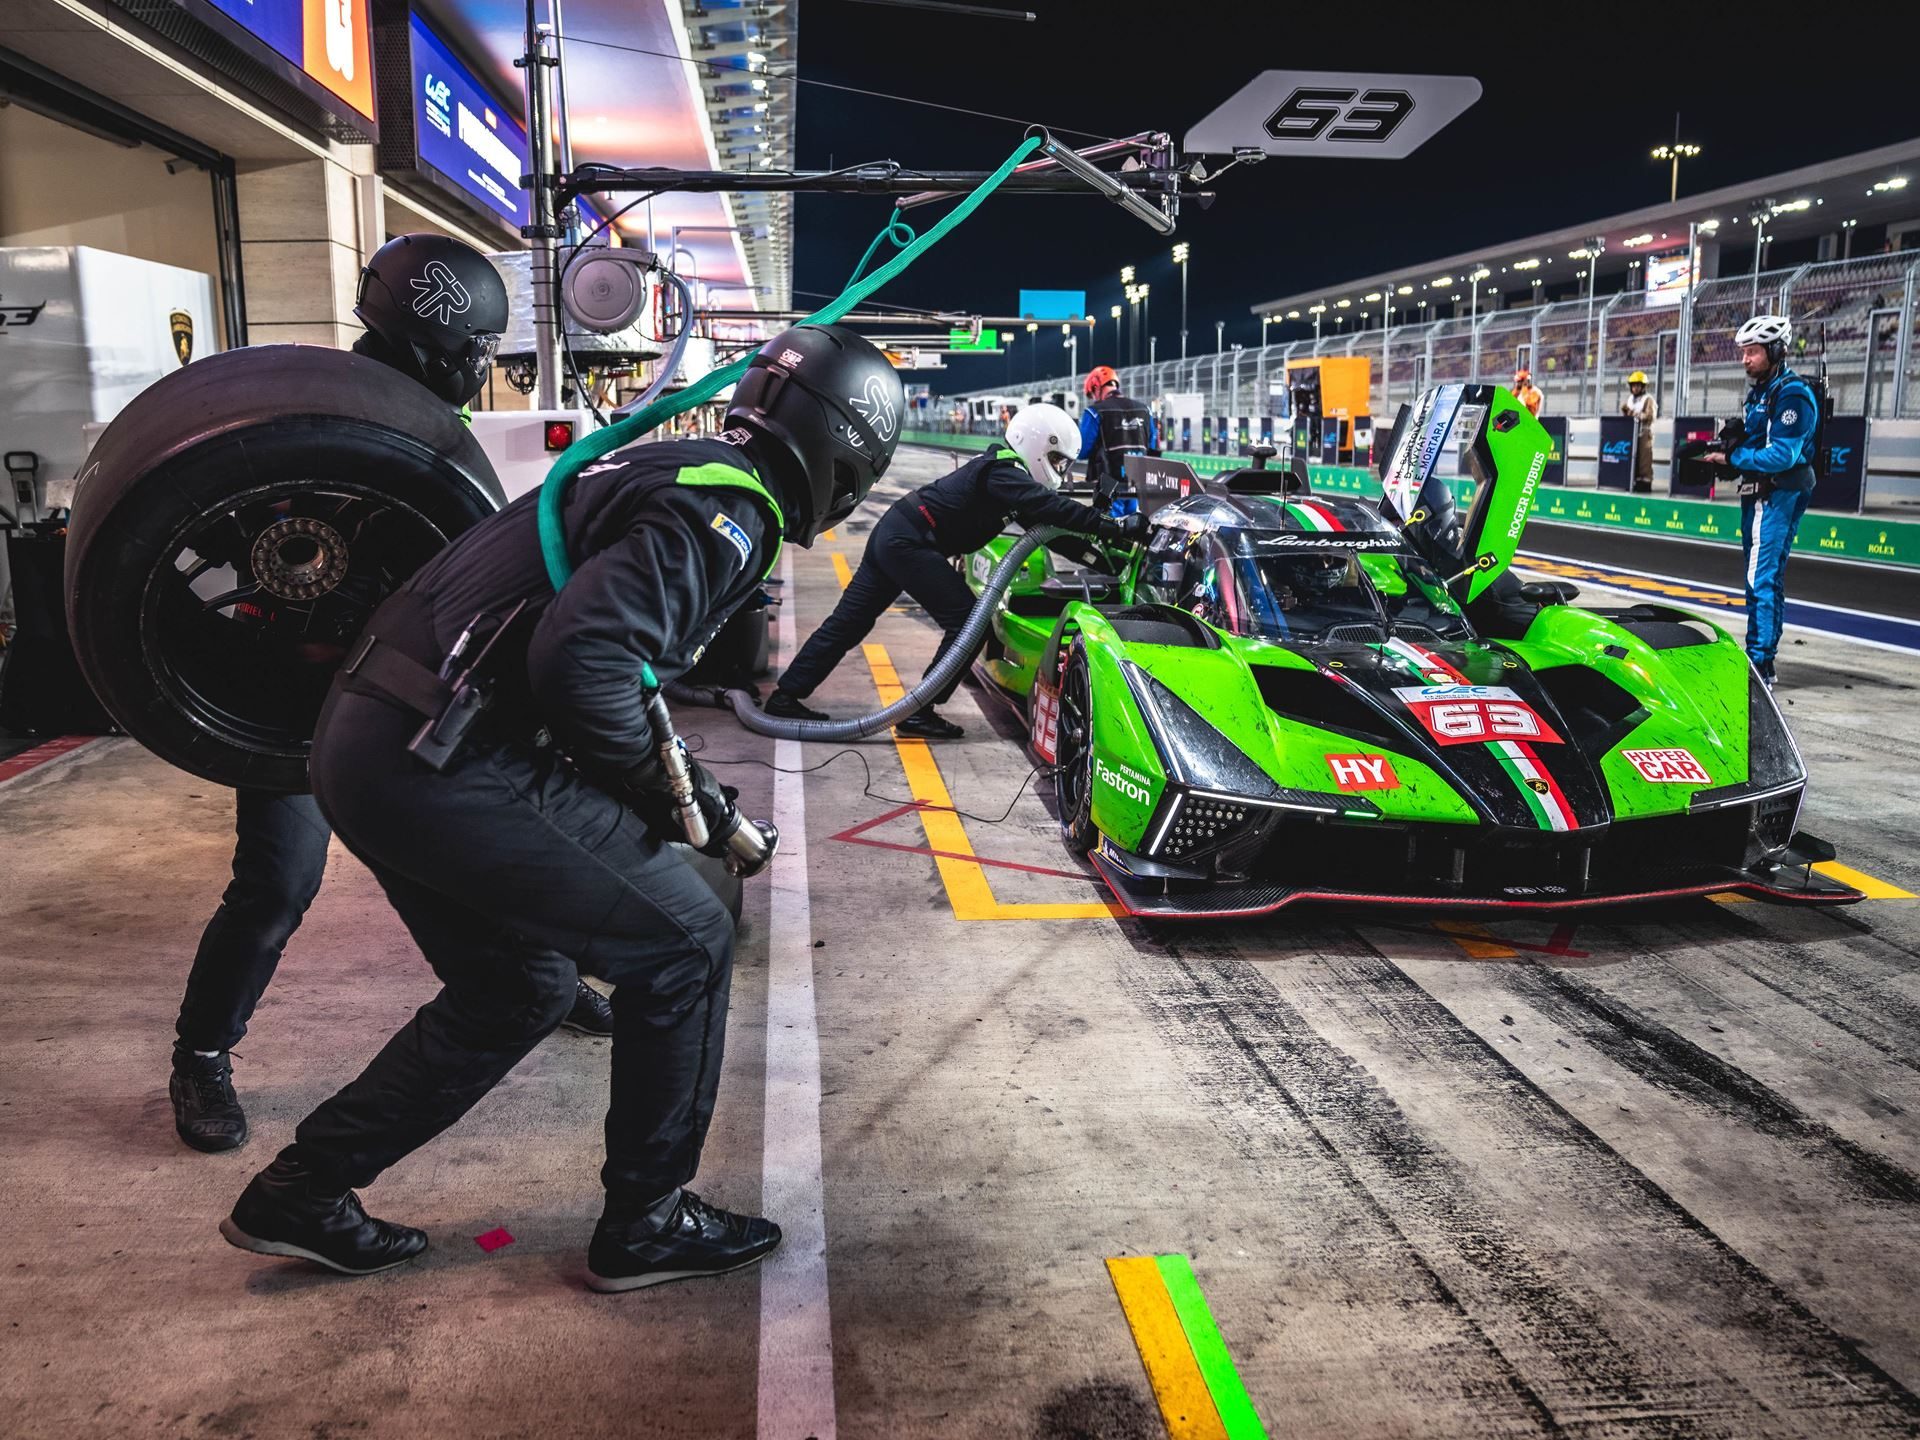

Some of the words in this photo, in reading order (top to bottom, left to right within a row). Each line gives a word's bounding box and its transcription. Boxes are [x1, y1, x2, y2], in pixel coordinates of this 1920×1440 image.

[1263, 86, 1416, 142] 63
[781, 350, 802, 364] OMP
[1410, 435, 1427, 467] KVYAT
[1419, 421, 1446, 469] MORTARA
[1602, 440, 1632, 455] WEC
[1830, 447, 1852, 464] EC
[1165, 475, 1179, 490] LYNX
[1415, 472, 1425, 481] E.
[1507, 497, 1530, 540] ROGER
[1522, 451, 1545, 496] DUBUIS
[1634, 517, 1651, 525] ROLEX
[1666, 521, 1684, 530] ROLEX
[1700, 525, 1719, 534] ROLEX
[1258, 535, 1401, 550] Lamborghini
[1820, 538, 1845, 550] ROLEX
[1868, 544, 1895, 556] ROLEX
[1421, 686, 1488, 695] WEC
[1429, 703, 1541, 738] 63
[1626, 751, 1691, 761] HYPER
[1120, 763, 1151, 786] PERTAMINA
[1335, 759, 1386, 785] HY
[1638, 761, 1706, 780] CAR
[1096, 758, 1150, 806] Fastron
